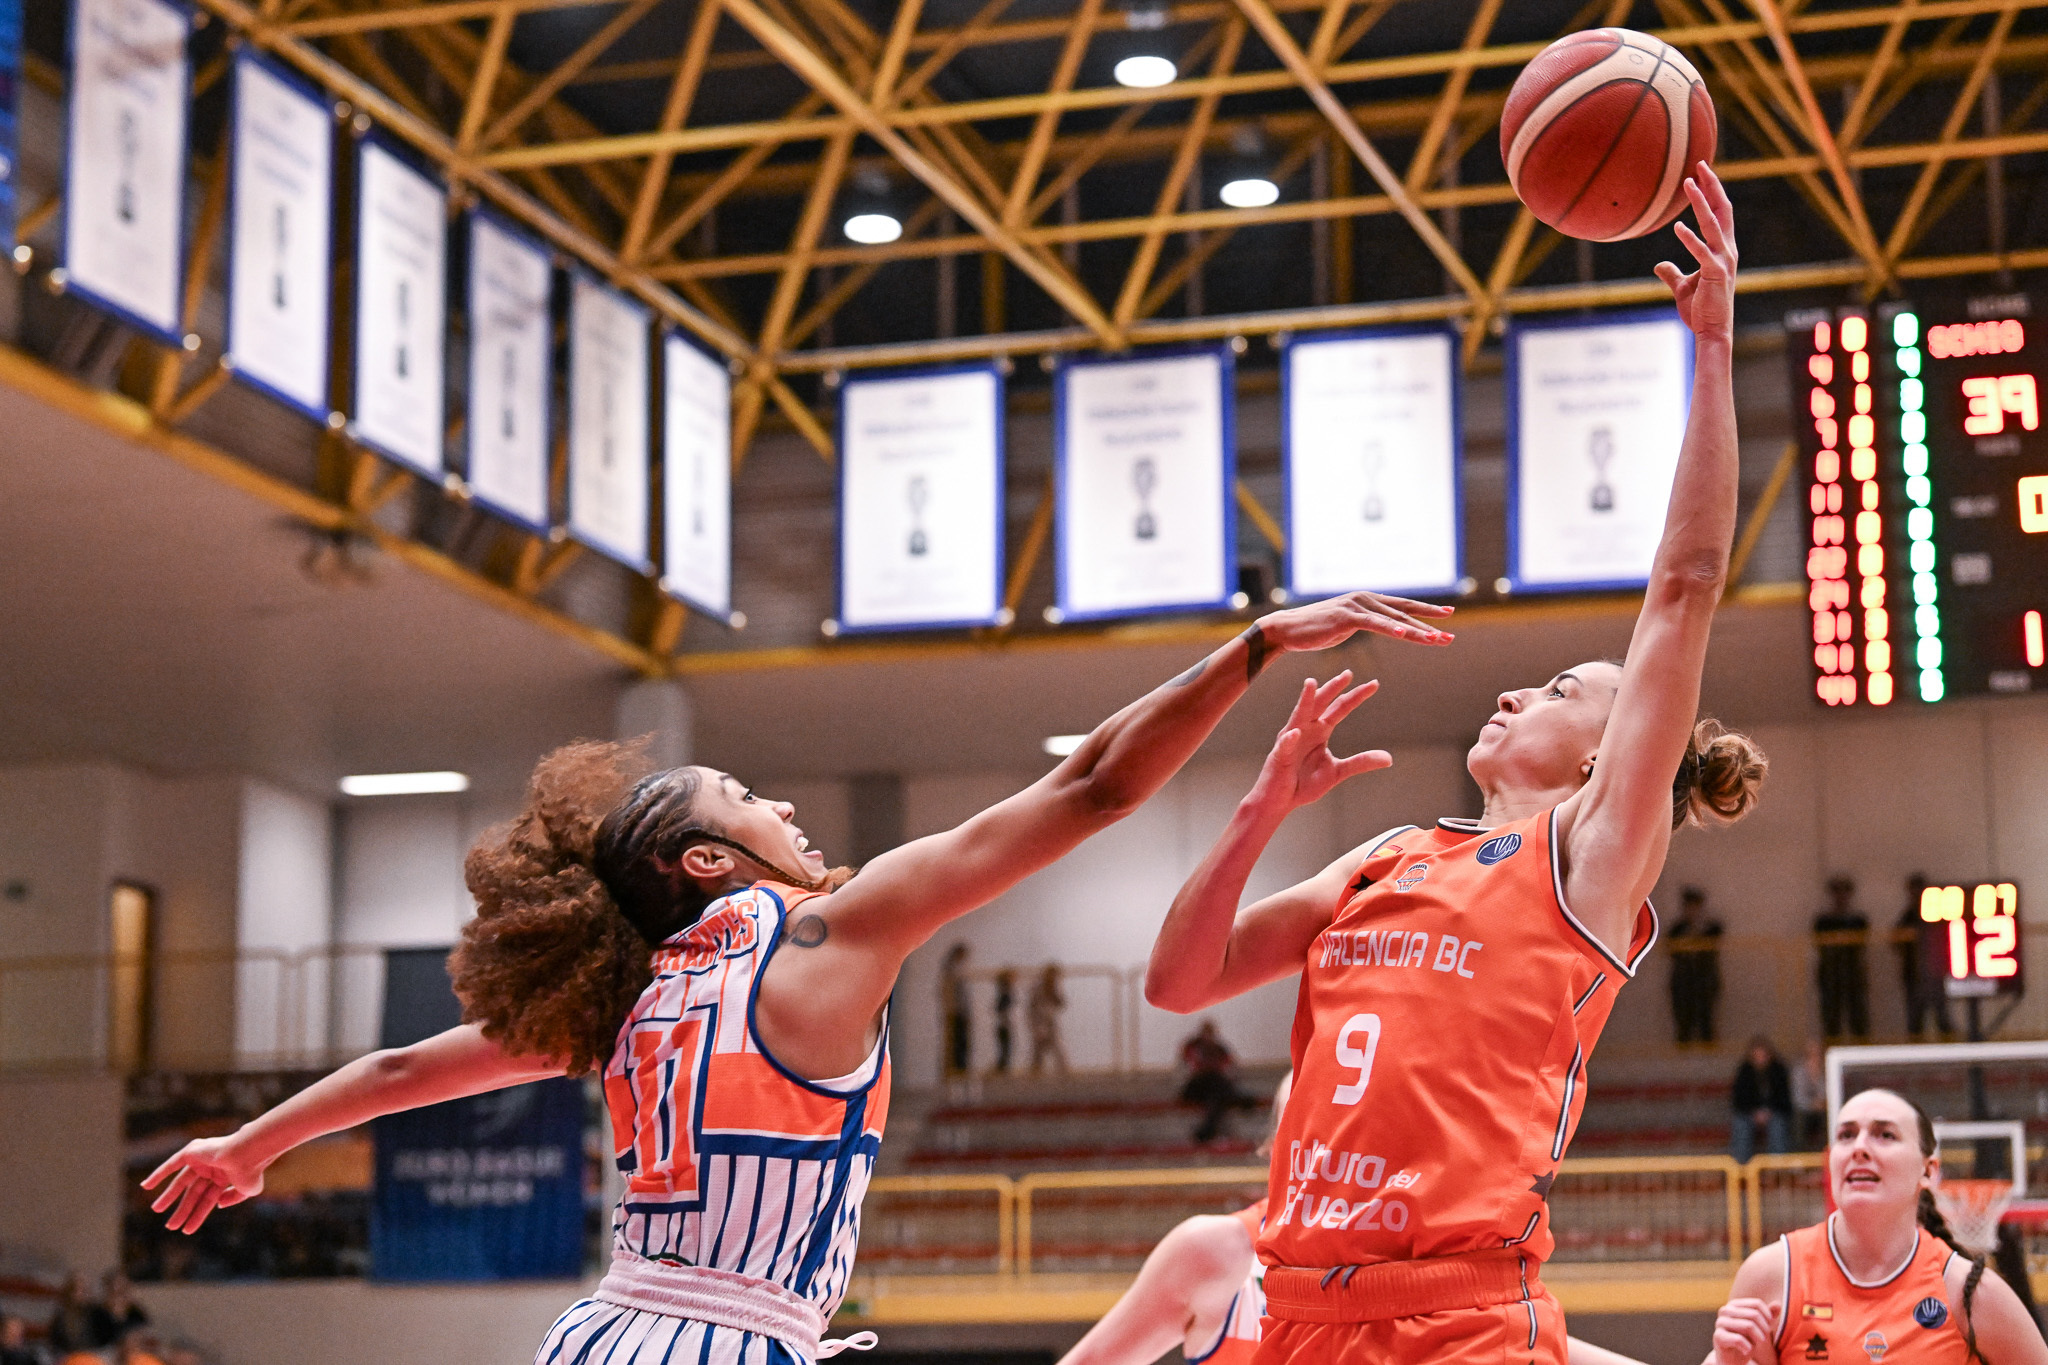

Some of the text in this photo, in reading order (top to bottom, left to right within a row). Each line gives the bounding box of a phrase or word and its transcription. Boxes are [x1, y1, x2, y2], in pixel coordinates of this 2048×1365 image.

[1961, 374, 2039, 436] 39
[1319, 930, 1484, 979] VALENCIA BC
[1948, 915, 2018, 979] 12
[1331, 1013, 1382, 1106] 9
[1288, 1139, 1422, 1189] Cultura del
[1276, 1181, 1409, 1232] Efuerzo
